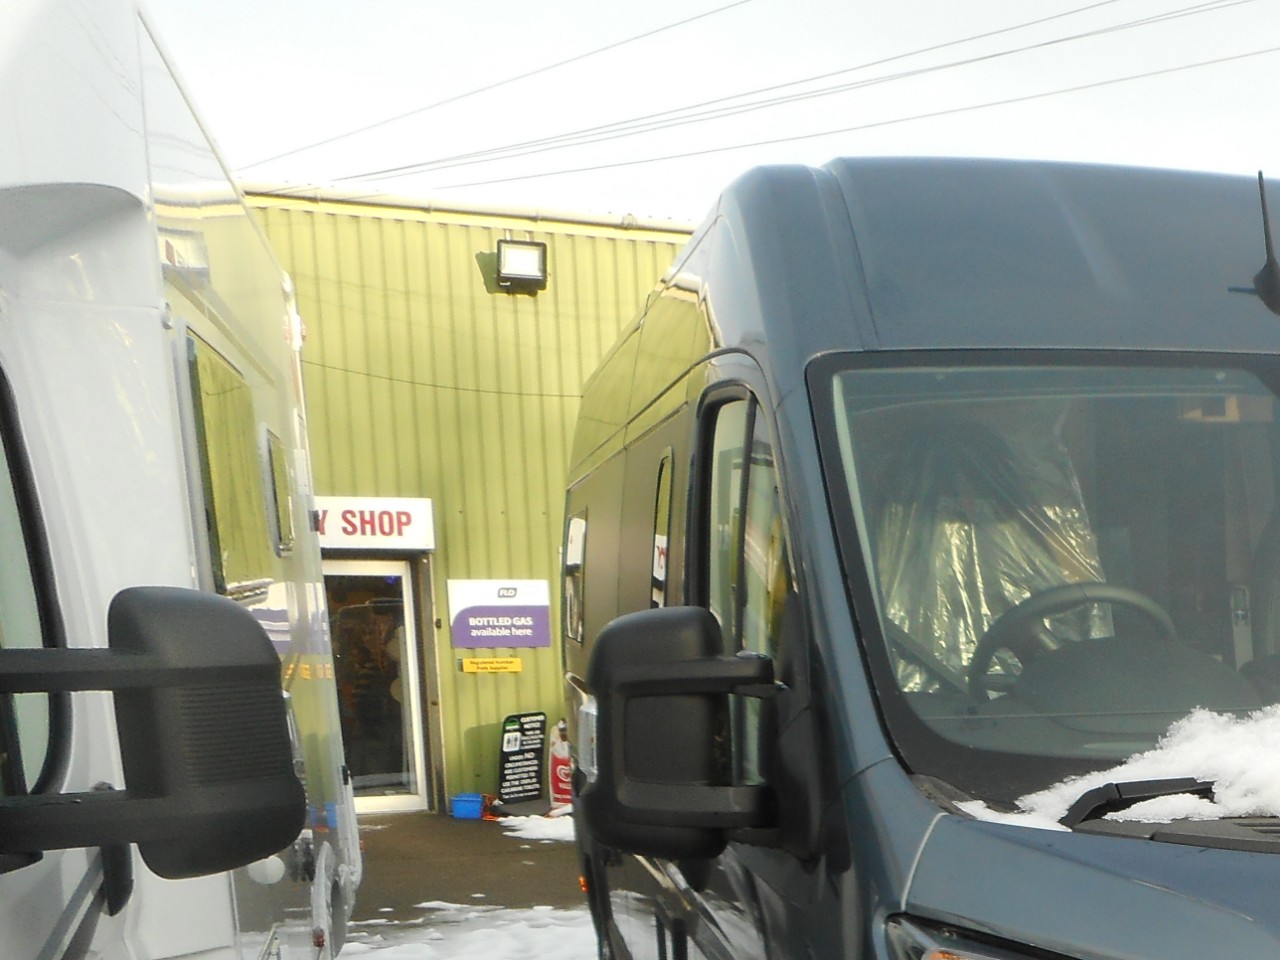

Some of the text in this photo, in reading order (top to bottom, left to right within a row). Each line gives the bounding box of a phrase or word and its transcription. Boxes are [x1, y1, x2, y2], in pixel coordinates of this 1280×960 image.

[341, 509, 412, 536] SHOP
[468, 617, 533, 626] BOTTLED GAS
[470, 627, 533, 636] available here
